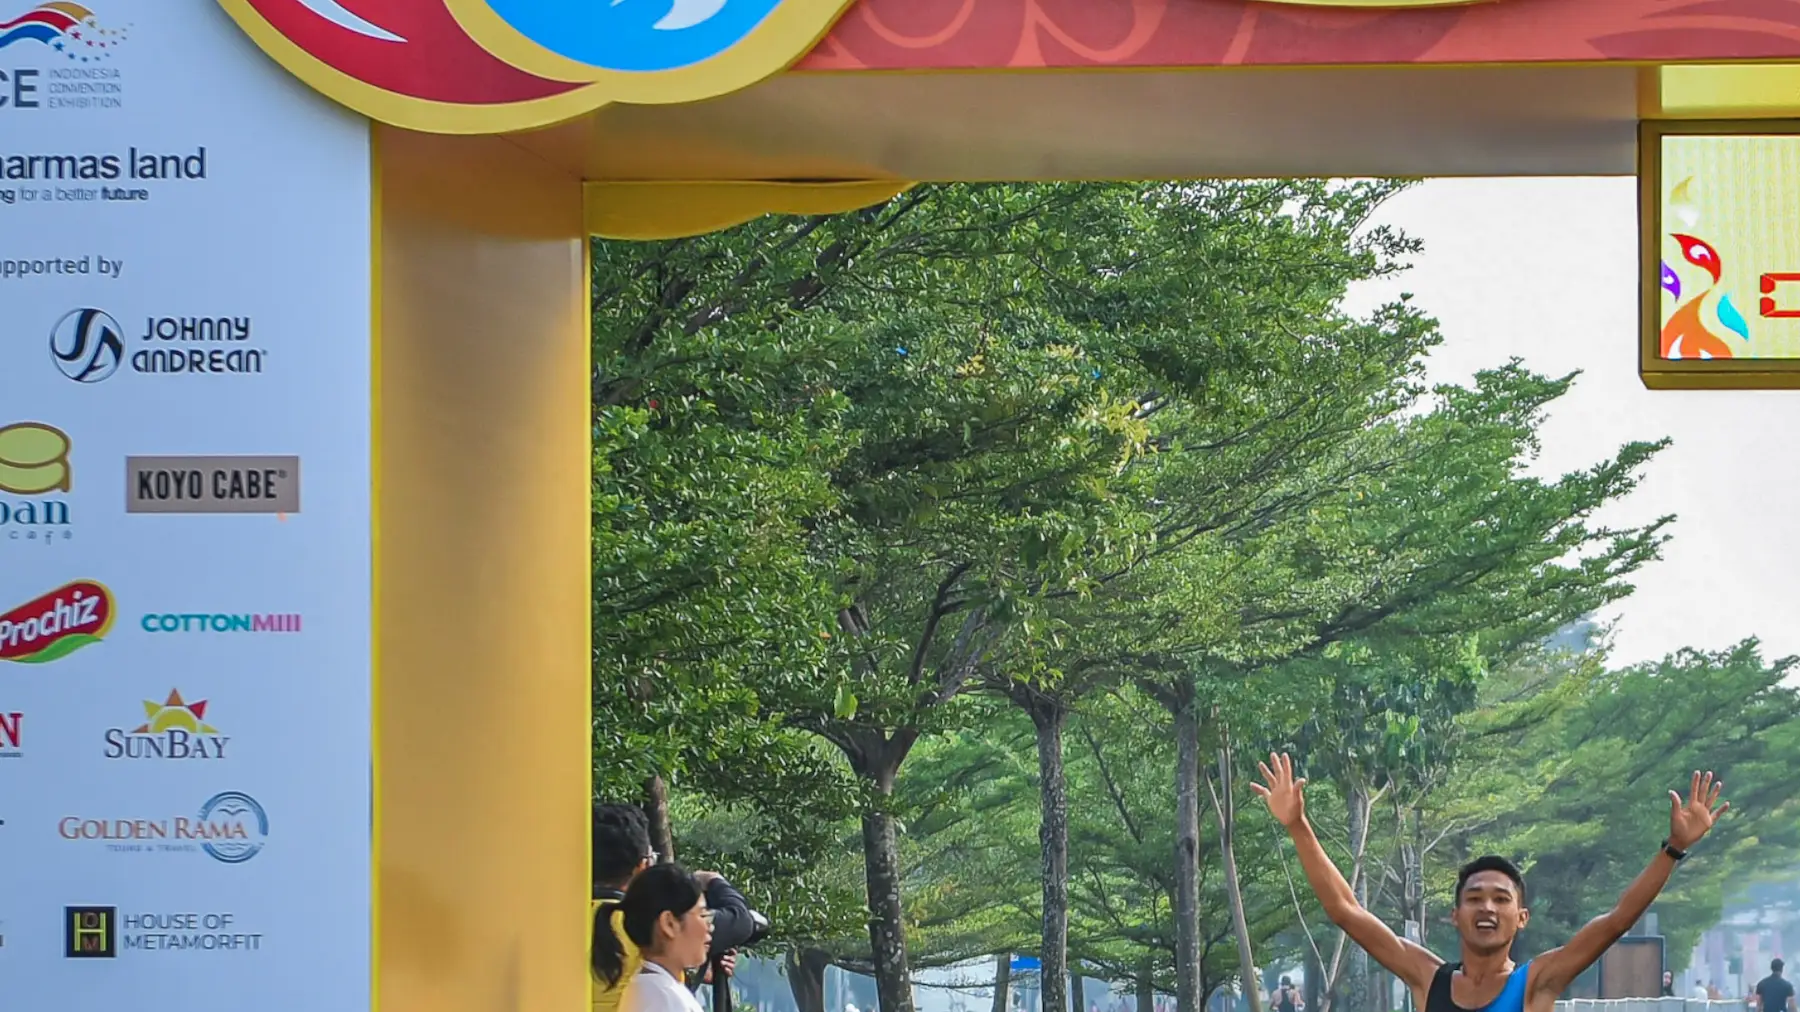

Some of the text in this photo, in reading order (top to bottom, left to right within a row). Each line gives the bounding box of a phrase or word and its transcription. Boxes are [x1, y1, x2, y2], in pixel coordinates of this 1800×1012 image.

[49, 69, 120, 79] INDONESIA
[49, 83, 121, 93] CONVENTION
[49, 97, 121, 108] EXHIBITION
[129, 147, 206, 179] land
[20, 187, 39, 200] for
[41, 190, 52, 200] a
[56, 187, 98, 200] better
[101, 187, 149, 200] future
[0, 255, 123, 278] pported by
[138, 471, 203, 500] KOYO
[0, 591, 100, 647] Prochiz
[58, 816, 248, 839] GOLDEN RAMA
[123, 914, 234, 929] HOUSE OF
[123, 934, 263, 950] METAMORFIT
